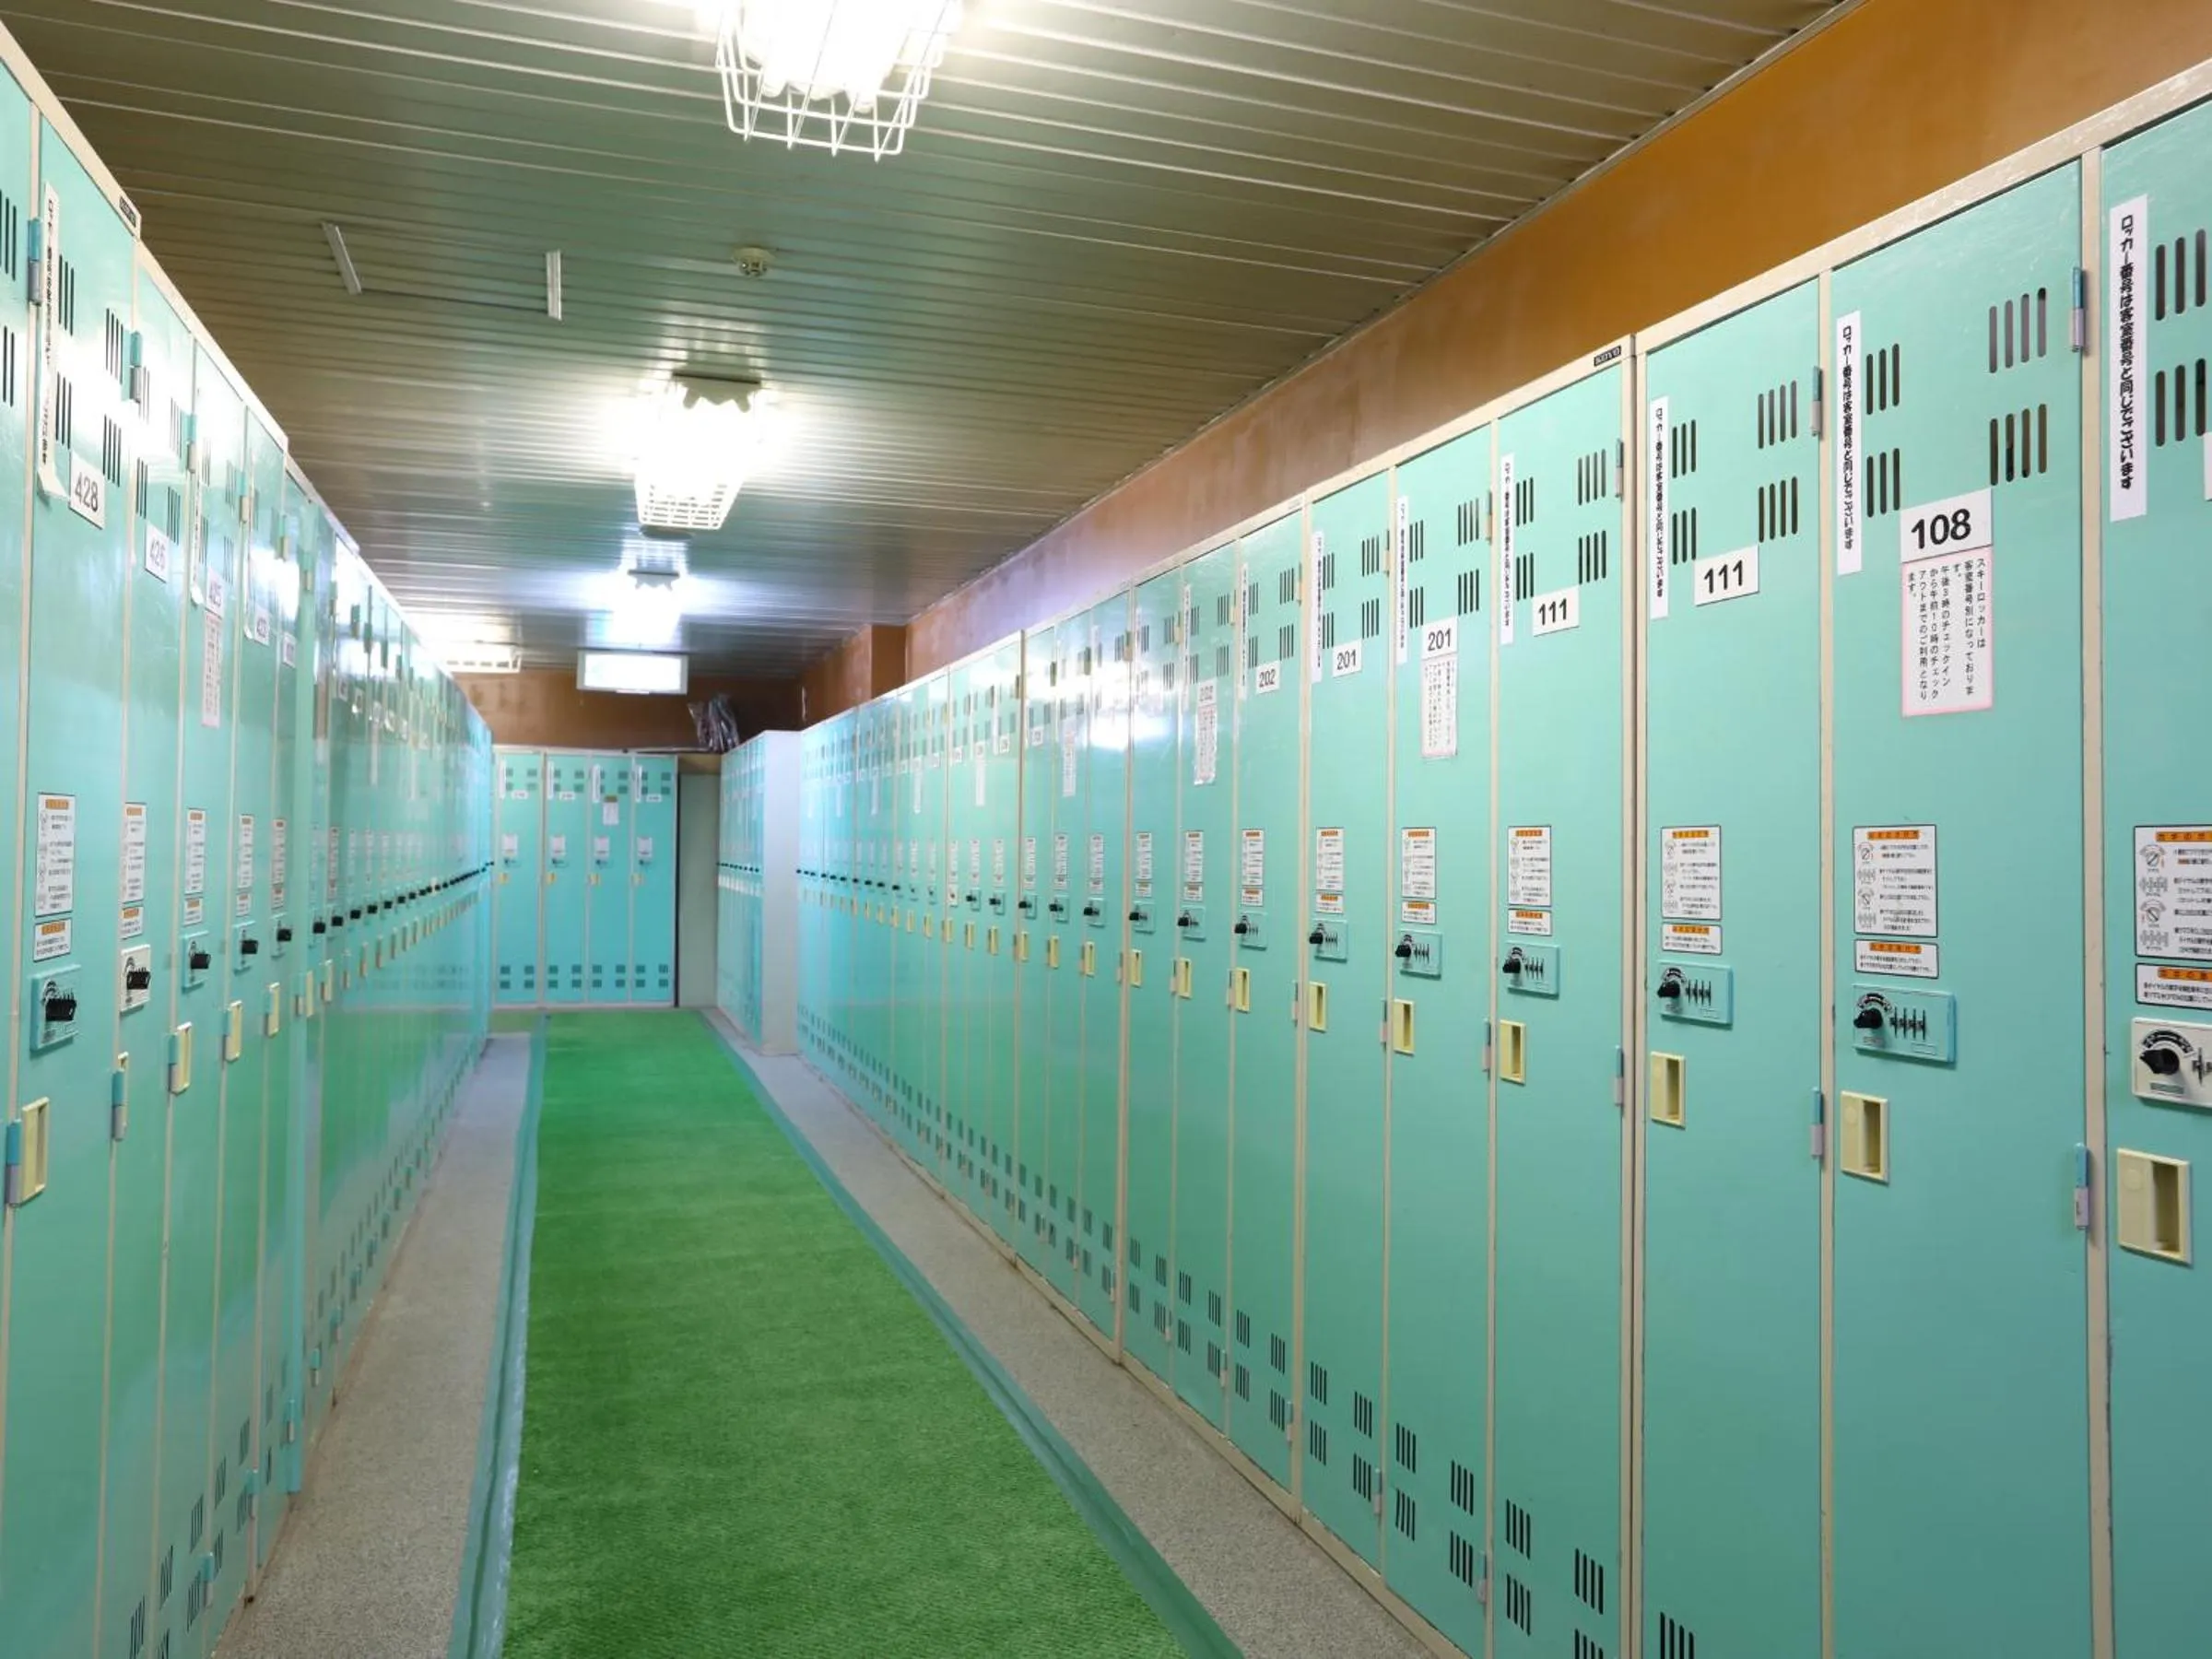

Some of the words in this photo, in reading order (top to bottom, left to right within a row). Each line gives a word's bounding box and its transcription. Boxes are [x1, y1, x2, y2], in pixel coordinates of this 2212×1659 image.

[74, 471, 99, 512] 428
[1911, 508, 1971, 549] 108
[1703, 559, 1743, 594] 111
[1537, 597, 1567, 626] 111
[1428, 627, 1451, 652] 201
[1336, 648, 1357, 671] 201
[1258, 668, 1277, 688] 202
